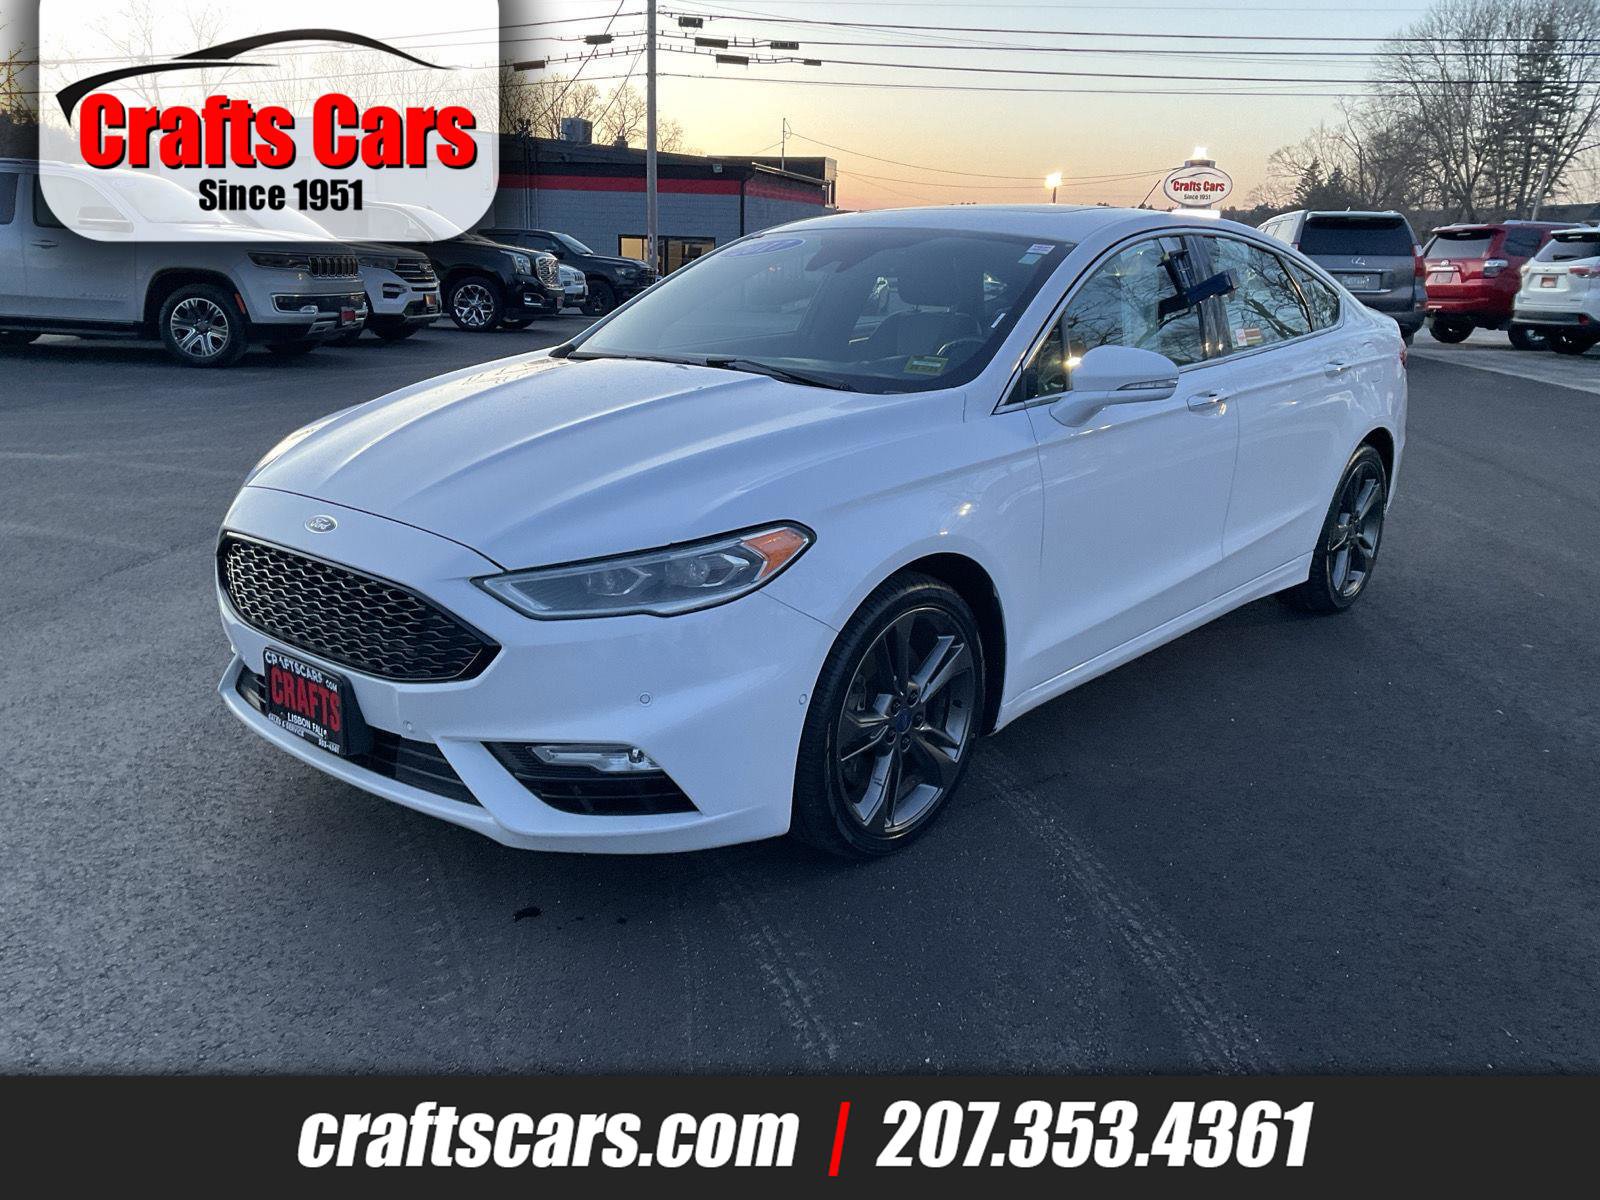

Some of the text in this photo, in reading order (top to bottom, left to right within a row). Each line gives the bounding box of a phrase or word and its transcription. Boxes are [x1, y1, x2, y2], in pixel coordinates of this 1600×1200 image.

[1173, 180, 1225, 192] Crafts Cars
[271, 665, 341, 733] CRAFTS
[287, 712, 311, 729] LISBON
